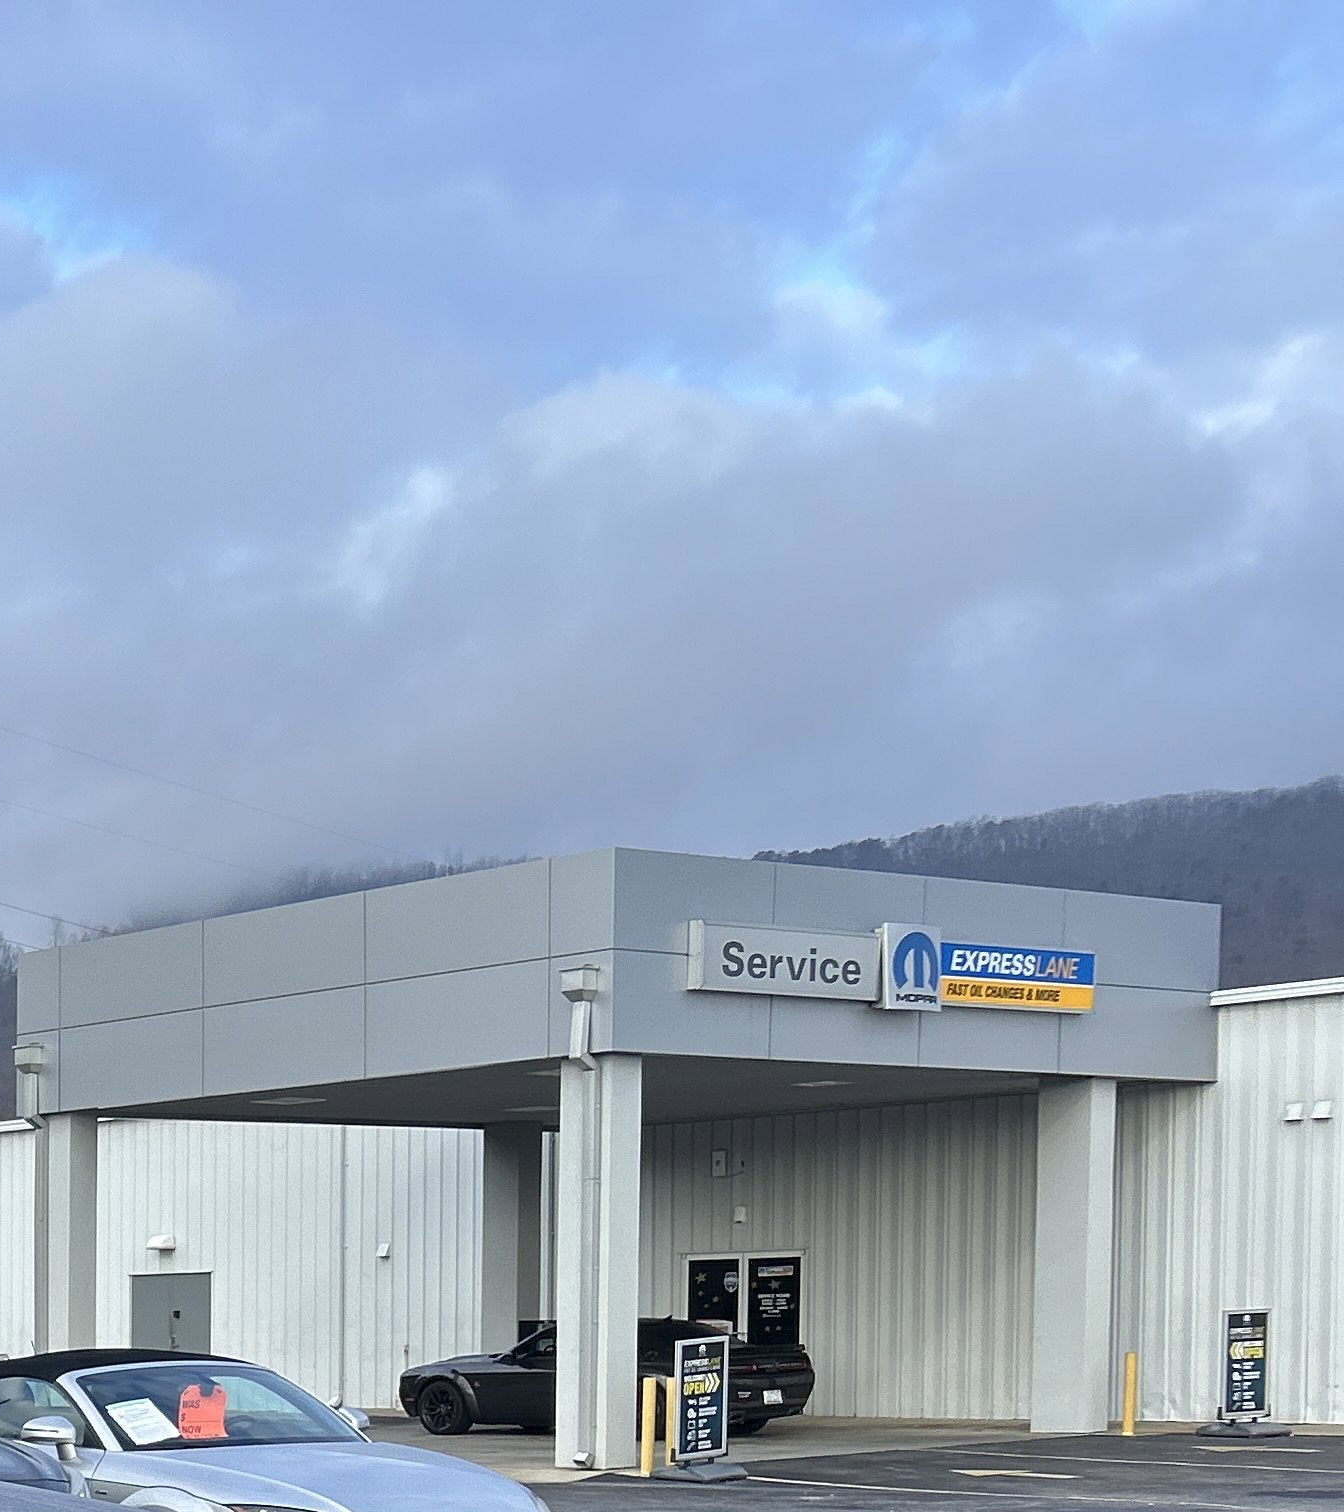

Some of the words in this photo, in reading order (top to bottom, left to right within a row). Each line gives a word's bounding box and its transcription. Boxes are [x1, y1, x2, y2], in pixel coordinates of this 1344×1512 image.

[722, 941, 861, 985] Service
[950, 949, 1081, 980] EXPRESSLANE
[895, 993, 938, 1005] MOPAR
[946, 983, 969, 996] FAST
[970, 984, 983, 997] OIL
[985, 986, 1025, 1000] CHANGES
[1035, 989, 1061, 1002] MORE
[683, 1381, 705, 1395] OPEN
[182, 1400, 200, 1409] WAS
[181, 1425, 202, 1434] NOW
